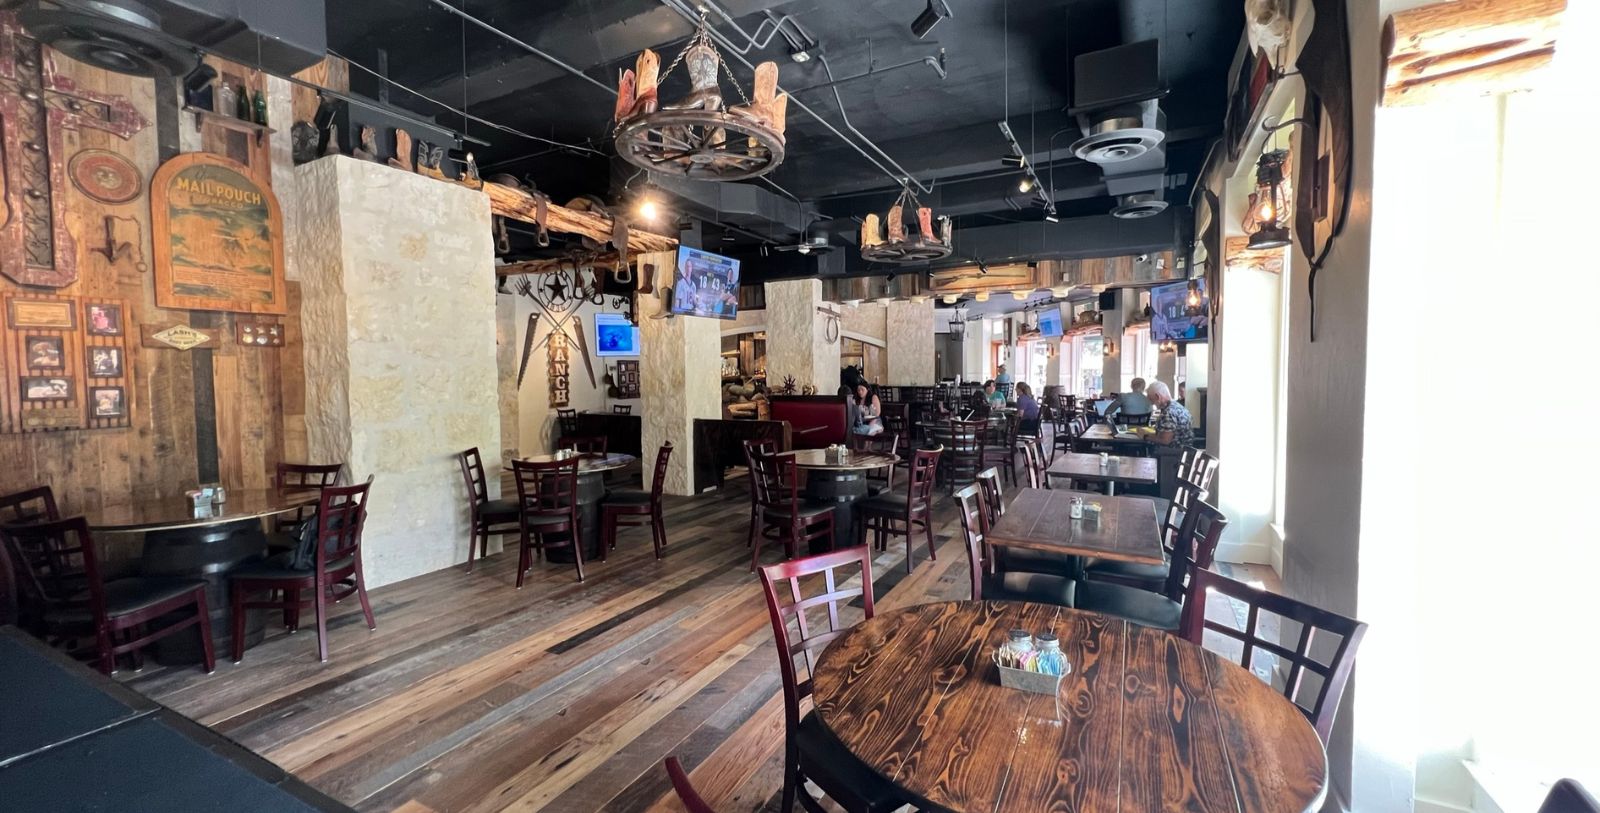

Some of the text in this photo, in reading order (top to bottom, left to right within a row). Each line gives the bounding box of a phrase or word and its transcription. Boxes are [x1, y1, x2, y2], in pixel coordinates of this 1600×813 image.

[177, 177, 261, 206] MAIL POUCH
[699, 275, 708, 289] 18
[711, 277, 720, 291] 43
[553, 333, 568, 404] RANCH
